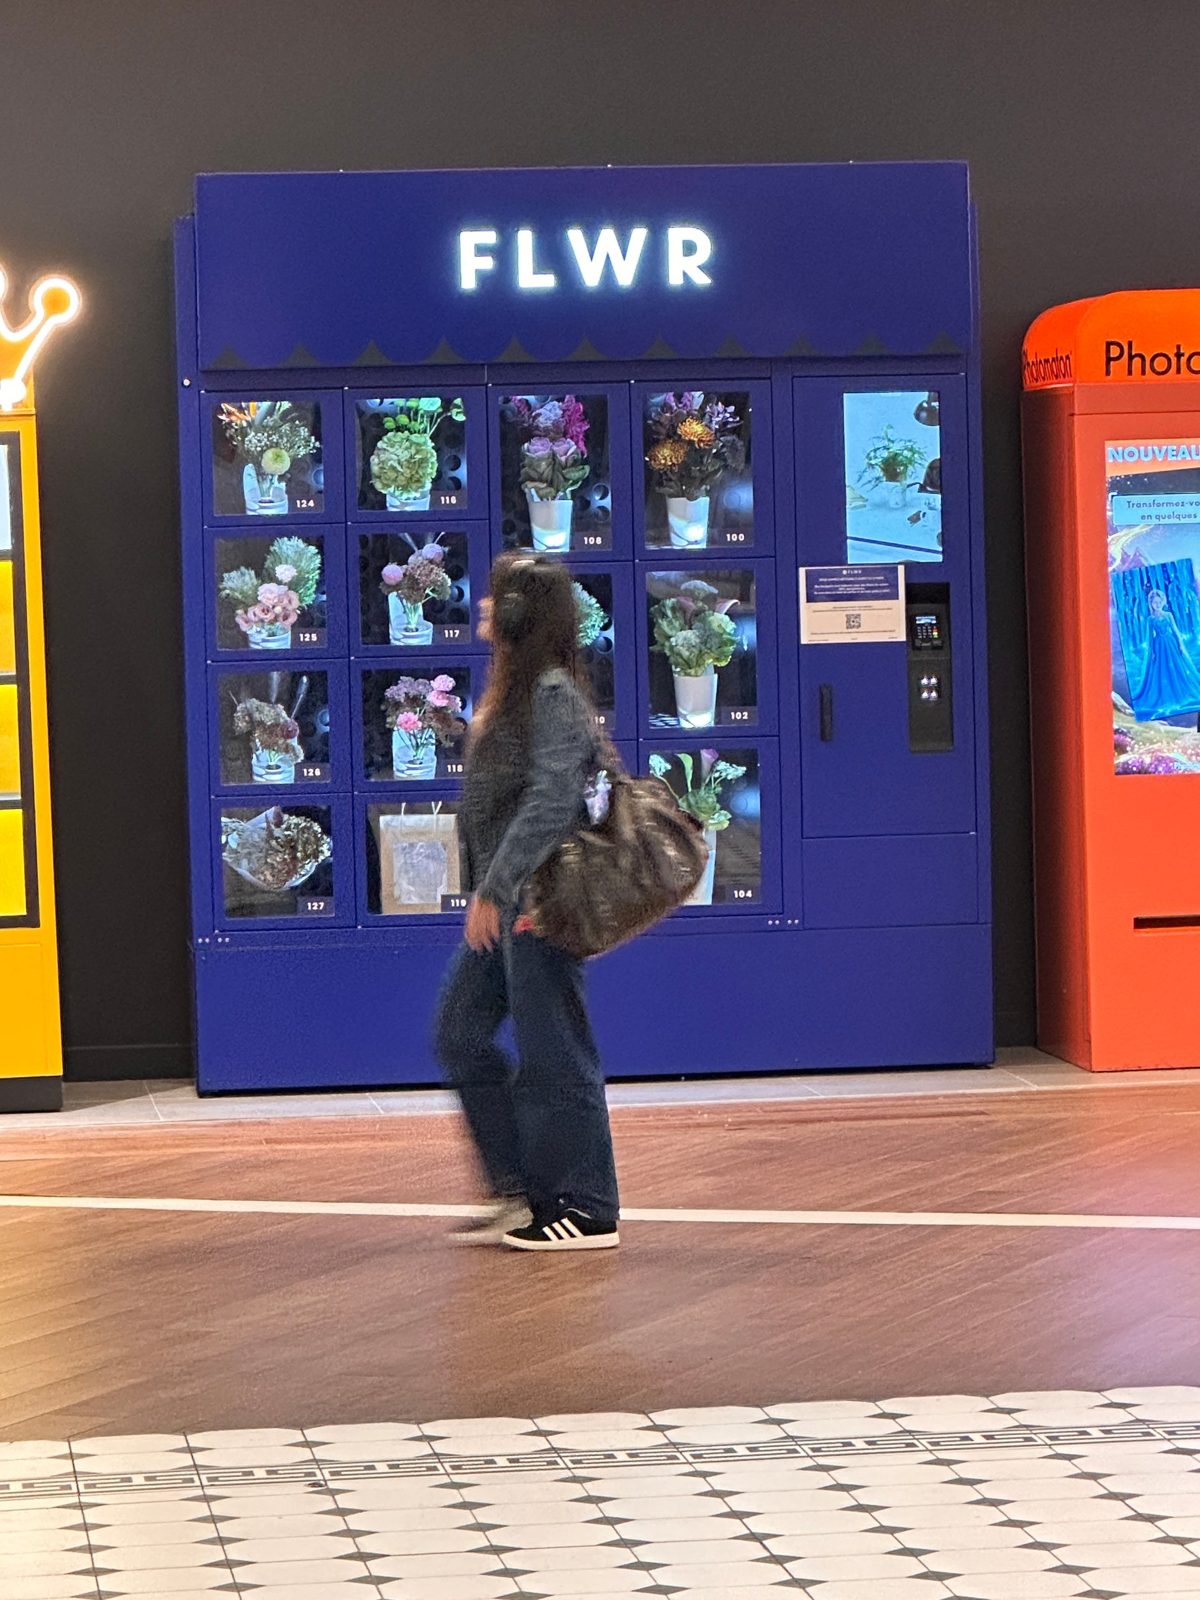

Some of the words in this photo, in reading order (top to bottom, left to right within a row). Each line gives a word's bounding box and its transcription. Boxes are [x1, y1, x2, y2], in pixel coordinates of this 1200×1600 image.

[459, 227, 713, 289] FLWR
[1107, 444, 1200, 463] NOUVEAU
[296, 499, 315, 508] 124
[440, 496, 457, 505] 116
[1155, 511, 1197, 522] quelques
[583, 536, 602, 545] 108
[726, 533, 745, 542] 100
[299, 632, 318, 642] 125
[444, 629, 460, 639] 117
[730, 711, 749, 720] 102
[733, 889, 753, 899] 104
[307, 901, 325, 911] 127
